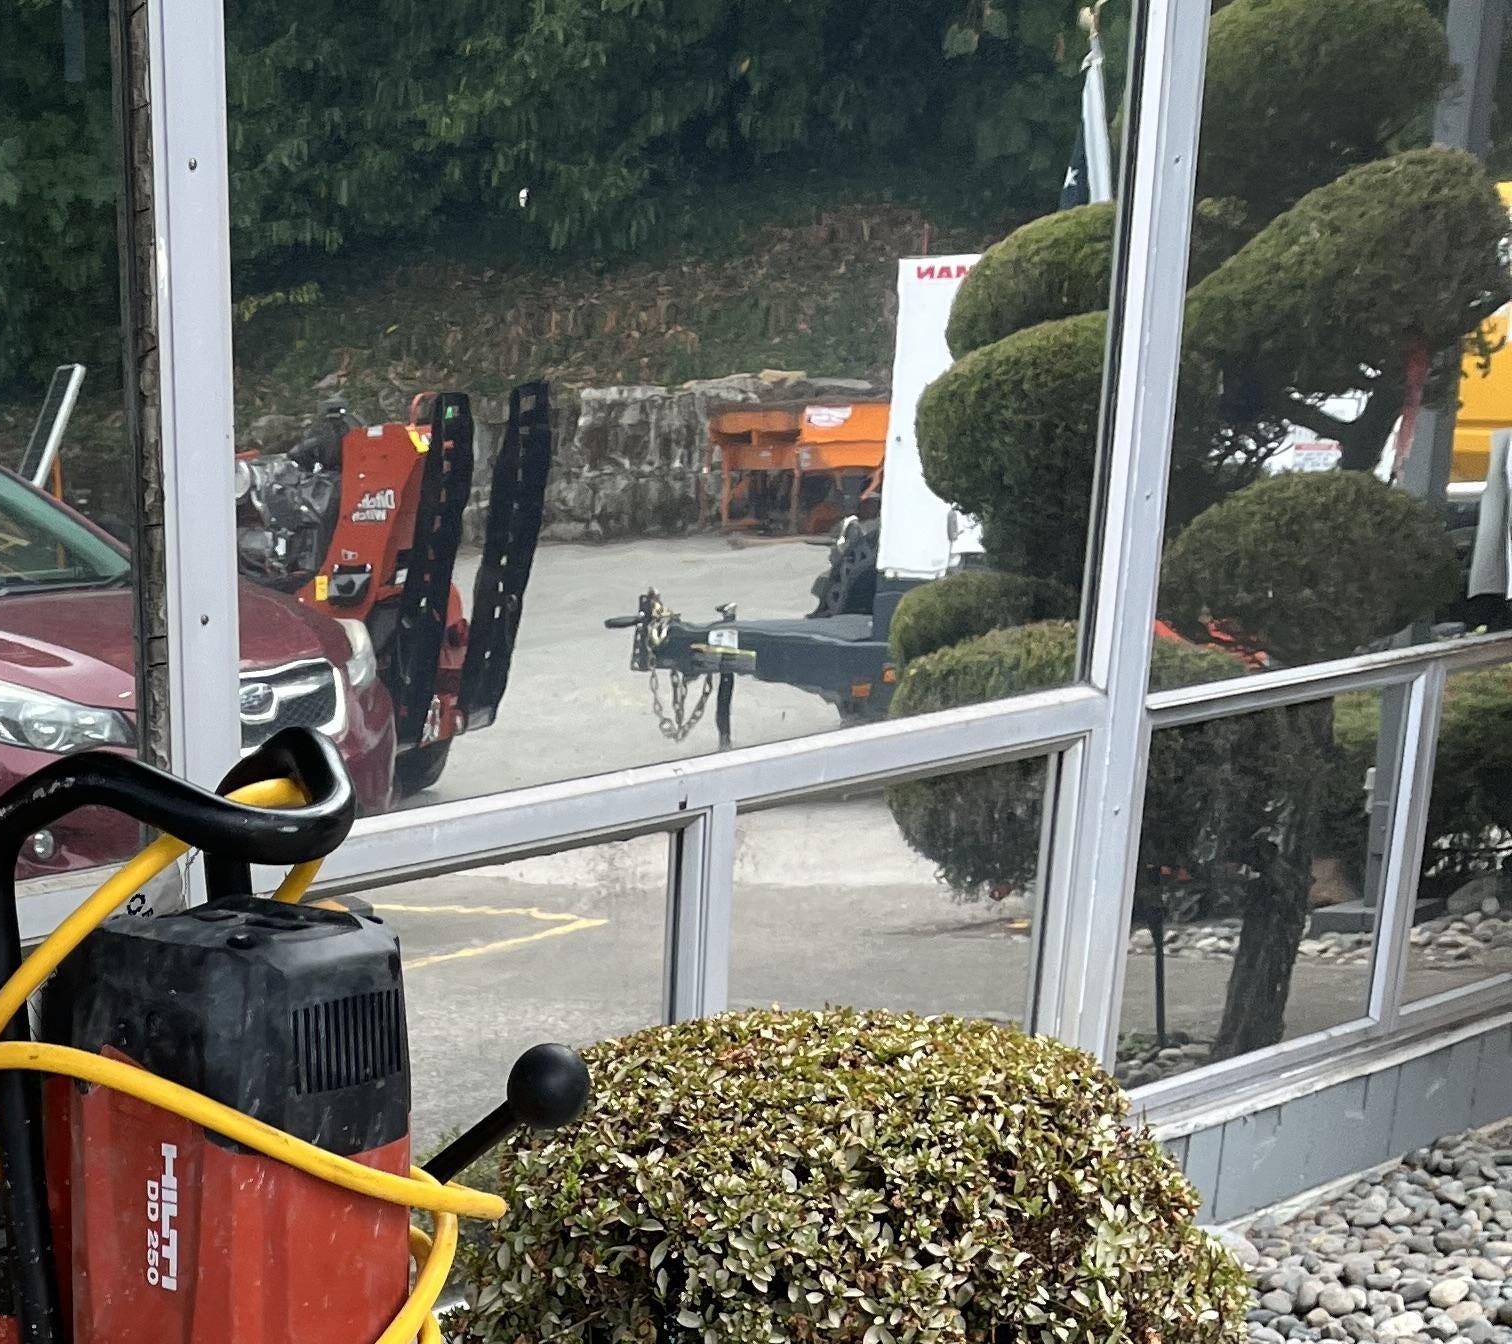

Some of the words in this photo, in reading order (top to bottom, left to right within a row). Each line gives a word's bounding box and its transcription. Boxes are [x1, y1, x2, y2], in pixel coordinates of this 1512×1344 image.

[147, 1180, 159, 1223] DD
[161, 1142, 178, 1291] HILTI
[147, 1228, 159, 1286] 250
